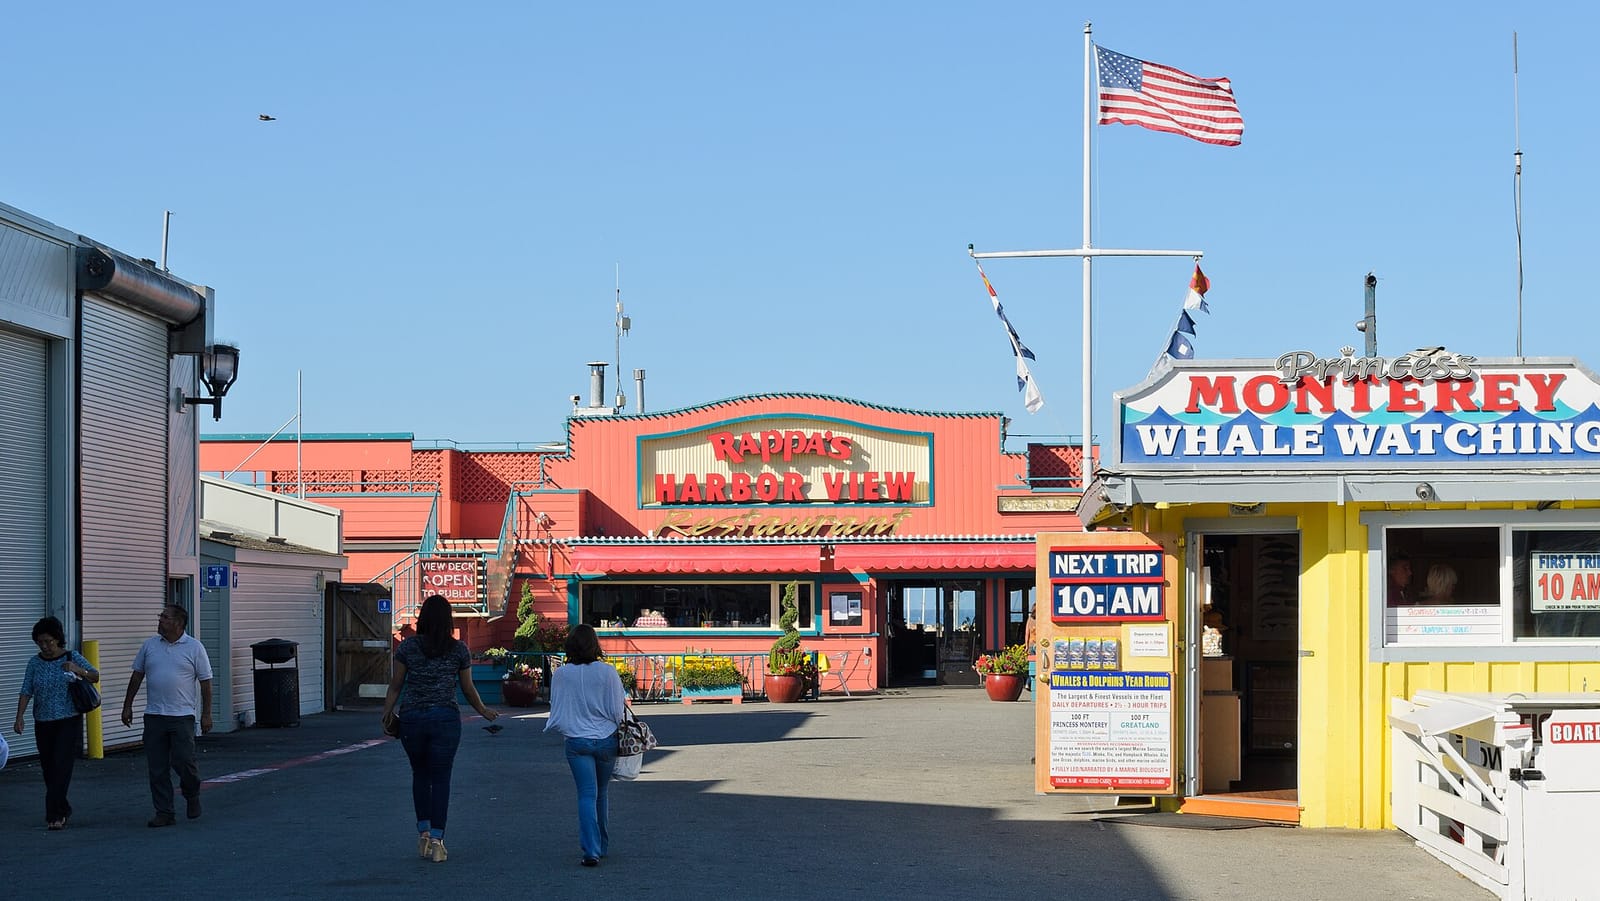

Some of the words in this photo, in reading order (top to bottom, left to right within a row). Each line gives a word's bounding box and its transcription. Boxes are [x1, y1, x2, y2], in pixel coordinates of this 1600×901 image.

[1275, 349, 1477, 384] Princess
[1184, 373, 1568, 414] MONTEREY
[1135, 423, 1325, 456] WHALE
[1333, 421, 1600, 456] WATCHING
[655, 471, 805, 503] HARBOR
[822, 471, 916, 501] VIEW
[653, 508, 913, 537] Restaurant
[421, 562, 446, 572] VIEW
[448, 562, 475, 573] DECK
[1055, 554, 1107, 574] NEXT
[1113, 553, 1159, 574] TRIP
[1538, 554, 1572, 569] FIRST
[432, 574, 474, 587] OPEN
[1537, 572, 1565, 601] 10
[1570, 572, 1600, 601] AM
[421, 589, 436, 599] TO
[437, 589, 475, 599] PUBLIC
[1110, 586, 1159, 614] AM
[1052, 675, 1081, 687] WHALES
[1082, 676, 1088, 687] &
[1089, 675, 1124, 688] DOLPHINS
[1125, 675, 1144, 688] YEAR
[1144, 676, 1169, 688] ROUND
[1068, 693, 1088, 701] Largest
[1070, 701, 1109, 709] DEPARTURES
[1120, 721, 1160, 729] GREATLAND
